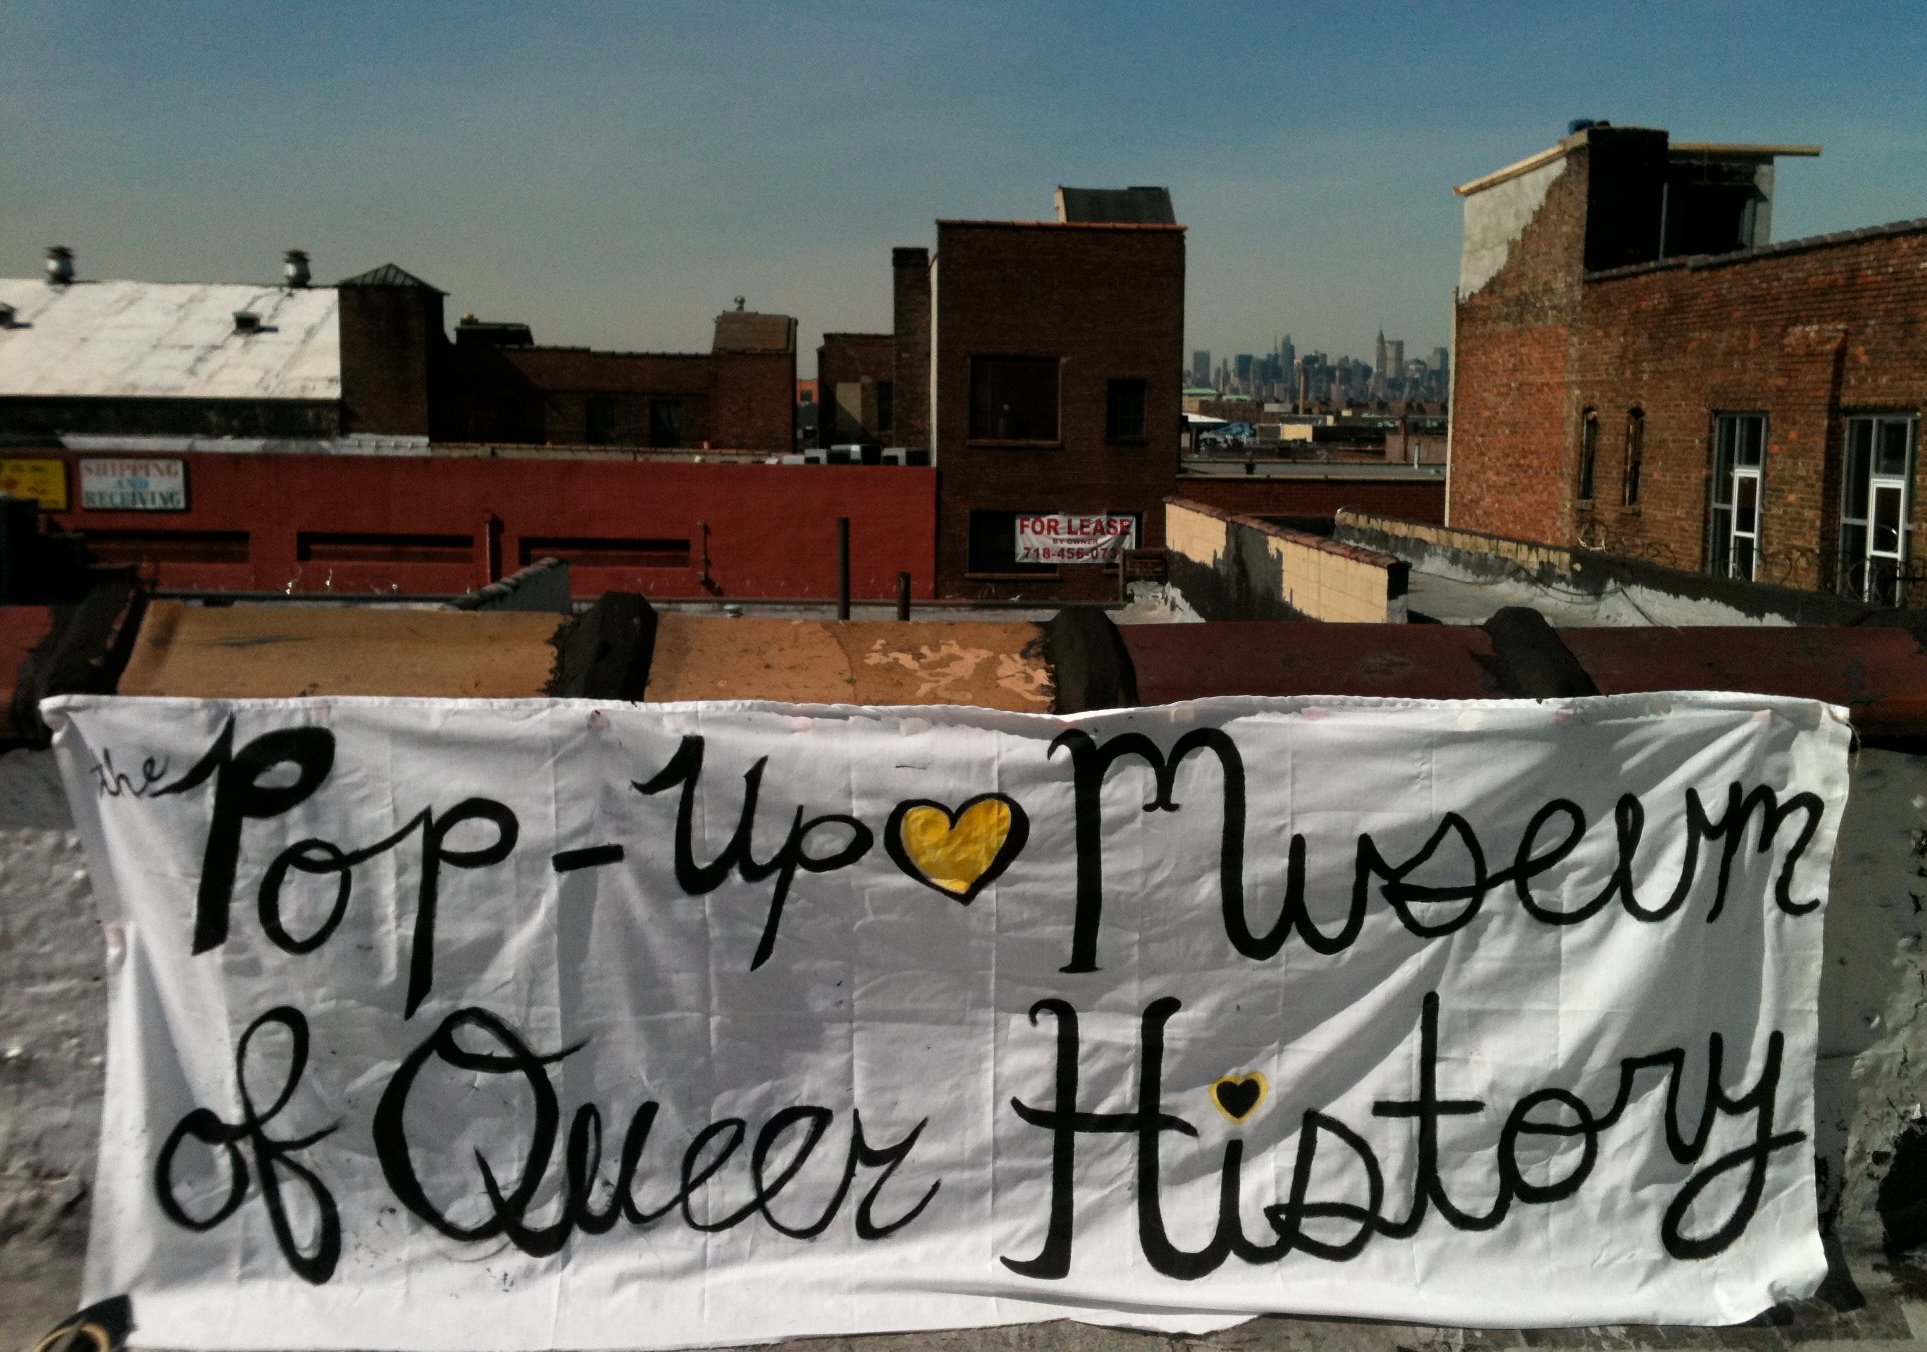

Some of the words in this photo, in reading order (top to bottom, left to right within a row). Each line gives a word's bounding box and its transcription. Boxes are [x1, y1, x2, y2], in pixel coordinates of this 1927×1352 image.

[1019, 516, 1060, 535] FOR
[1067, 518, 1133, 536] LEASE
[90, 748, 168, 798] the
[1047, 727, 1825, 974] Museum
[154, 1006, 342, 1286] of
[372, 1006, 942, 1259] Queer
[1000, 990, 1806, 1281] History
